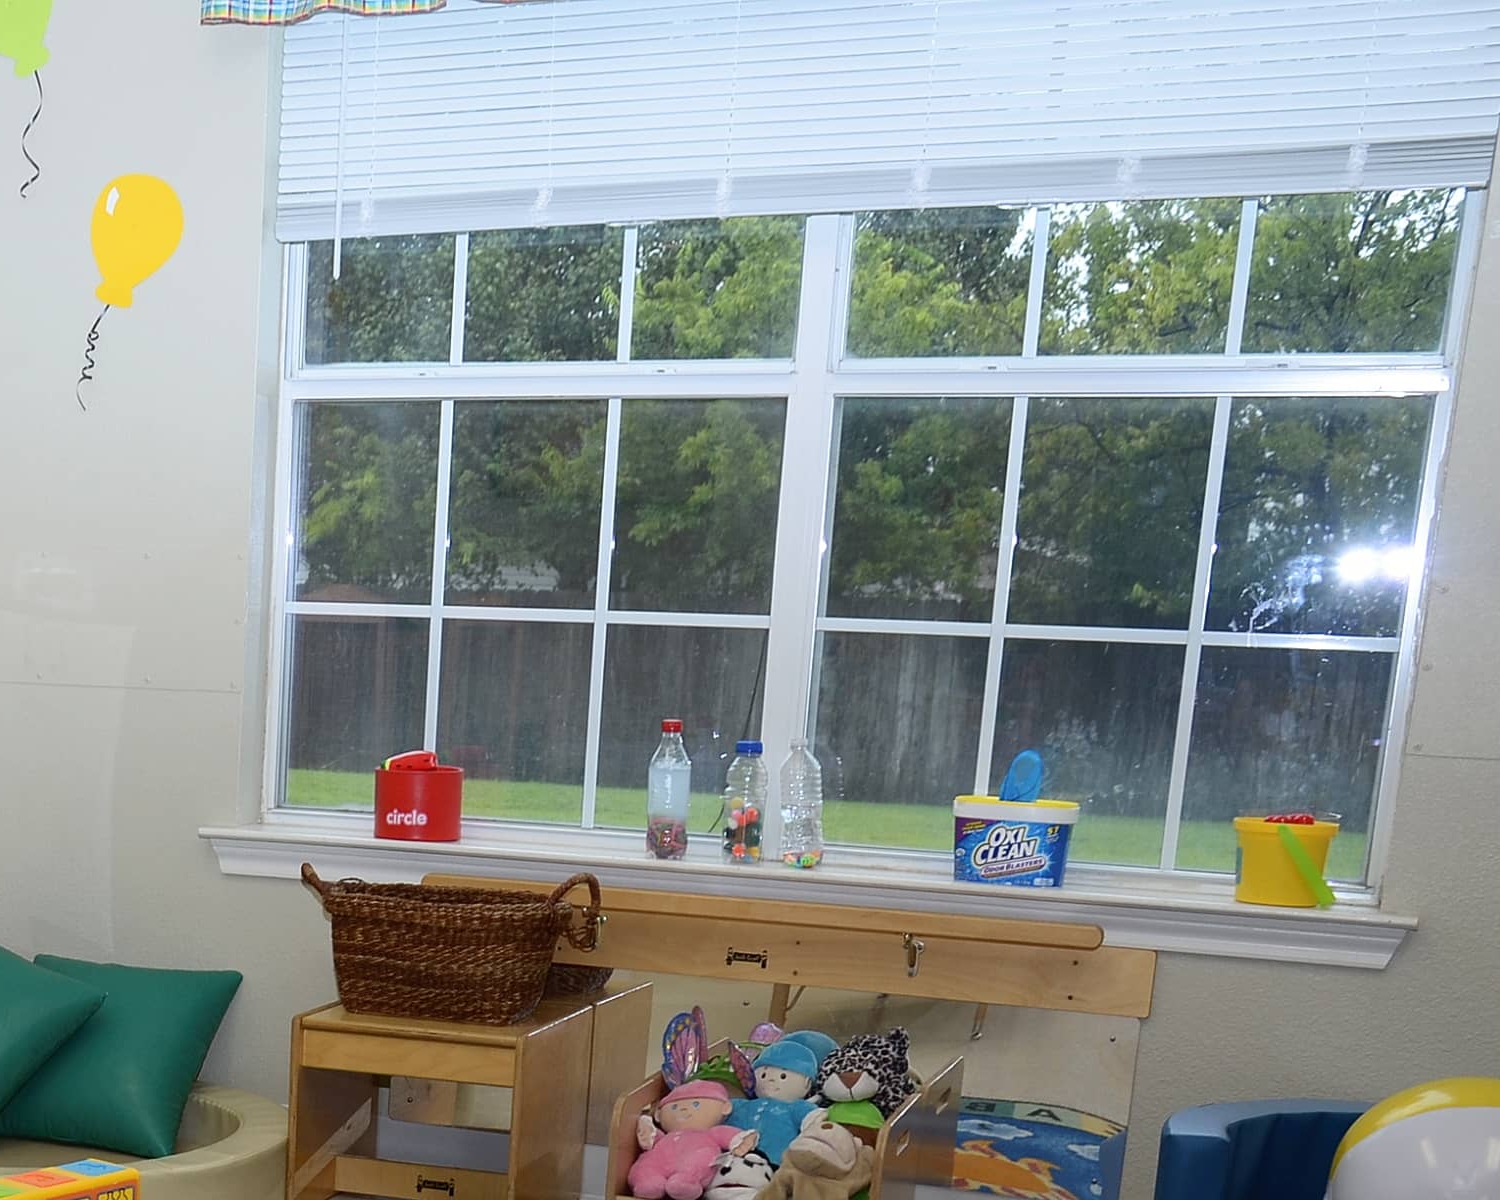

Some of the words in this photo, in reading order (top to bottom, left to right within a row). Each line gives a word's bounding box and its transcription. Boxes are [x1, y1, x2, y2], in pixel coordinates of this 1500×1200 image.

[386, 809, 428, 826] circle
[989, 826, 1026, 845] OXI
[974, 840, 1037, 865] CLEAN
[984, 864, 1005, 873] ODOR
[1005, 859, 1043, 870] BLASTERS
